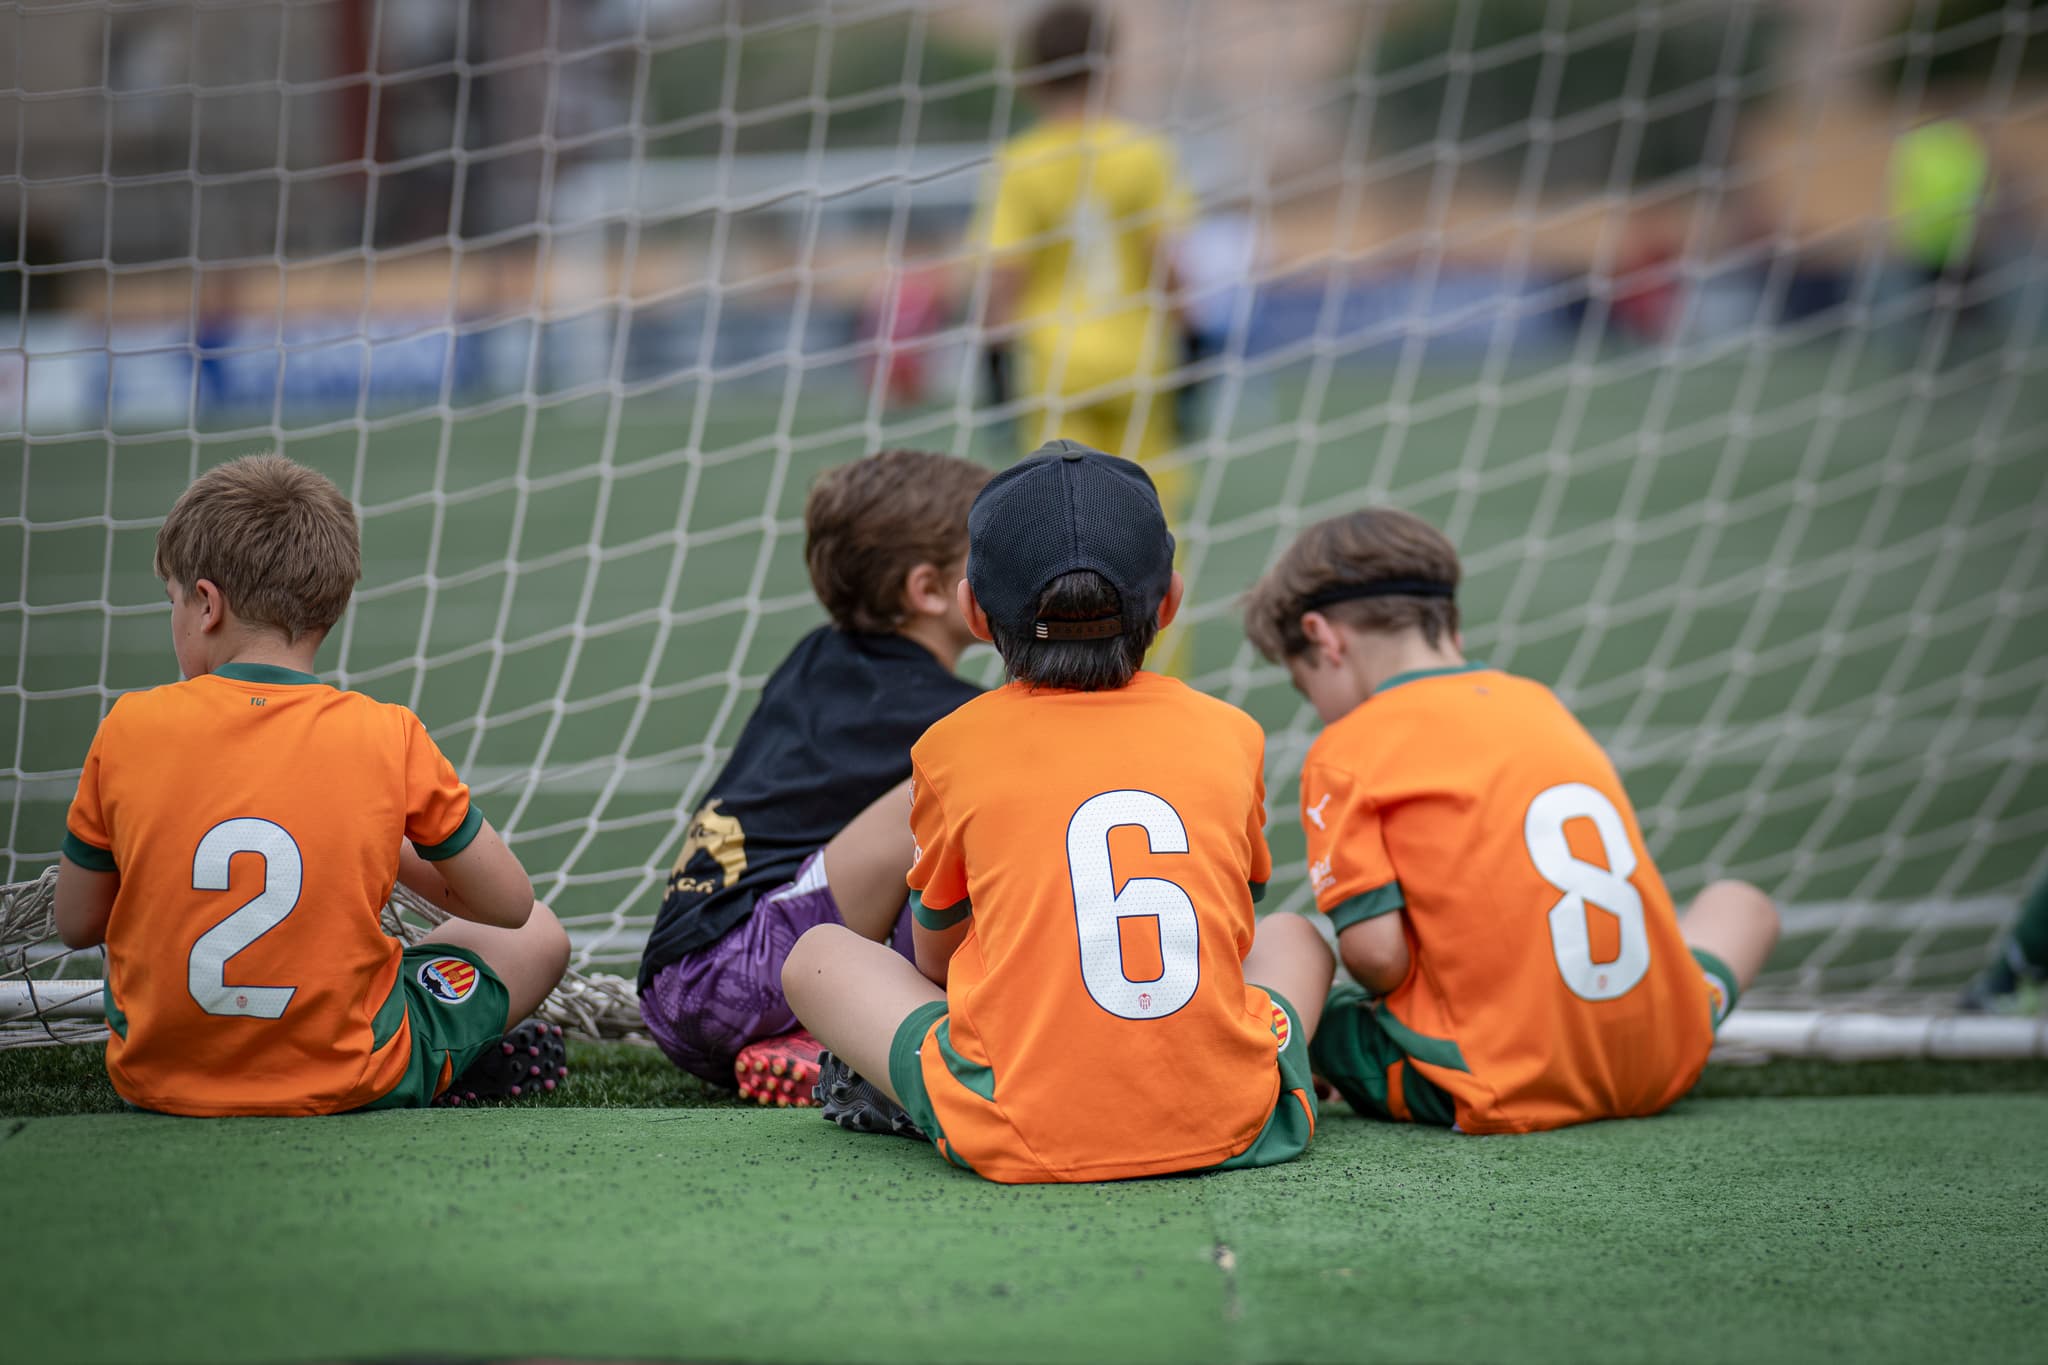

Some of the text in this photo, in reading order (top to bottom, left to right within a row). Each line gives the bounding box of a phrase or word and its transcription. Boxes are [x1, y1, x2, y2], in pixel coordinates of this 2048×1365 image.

[189, 817, 303, 1018] 2
[1066, 789, 1200, 1020] 6
[1525, 783, 1650, 1000] 8
